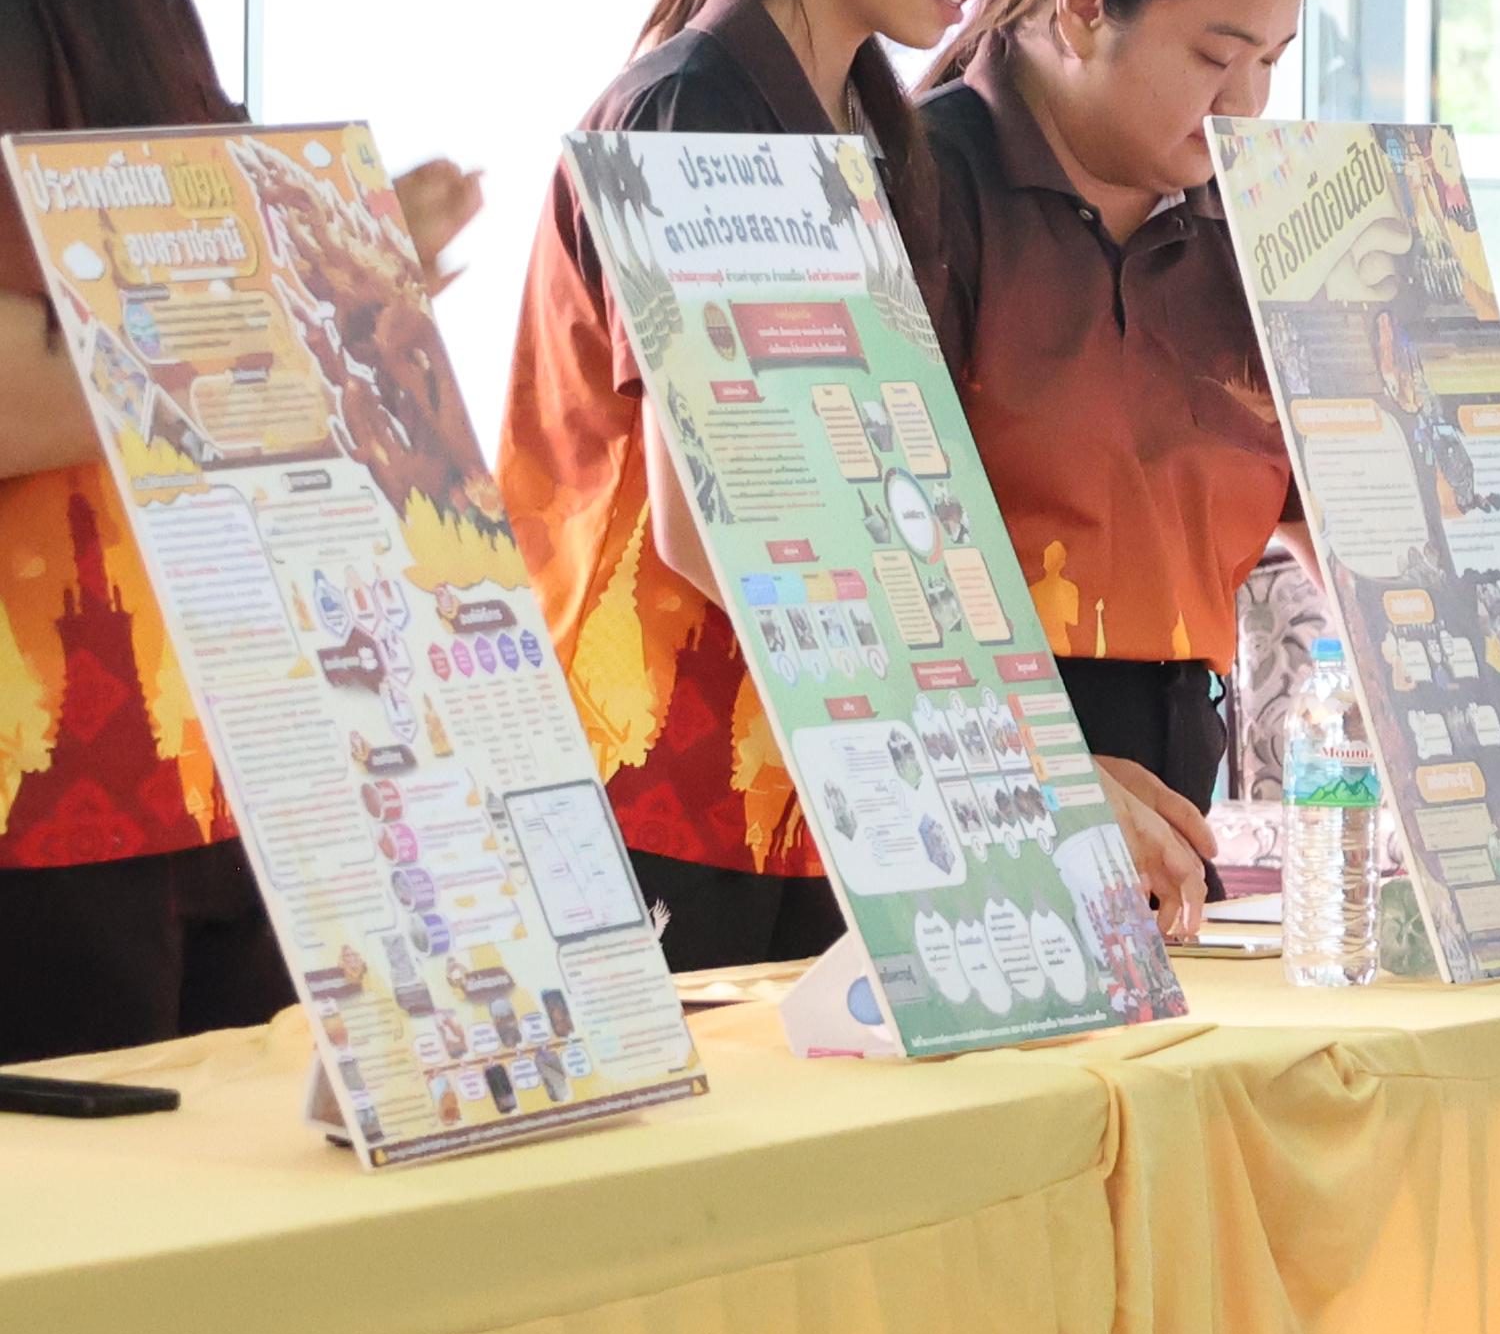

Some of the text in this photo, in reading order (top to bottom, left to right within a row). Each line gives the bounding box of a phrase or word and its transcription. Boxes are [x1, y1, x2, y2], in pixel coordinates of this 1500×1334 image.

[358, 142, 374, 165] 4
[678, 141, 784, 189] ประเพณี
[1440, 143, 1452, 168] 2
[850, 158, 865, 184] 3
[1254, 141, 1386, 296] สารทเดือนสิบ
